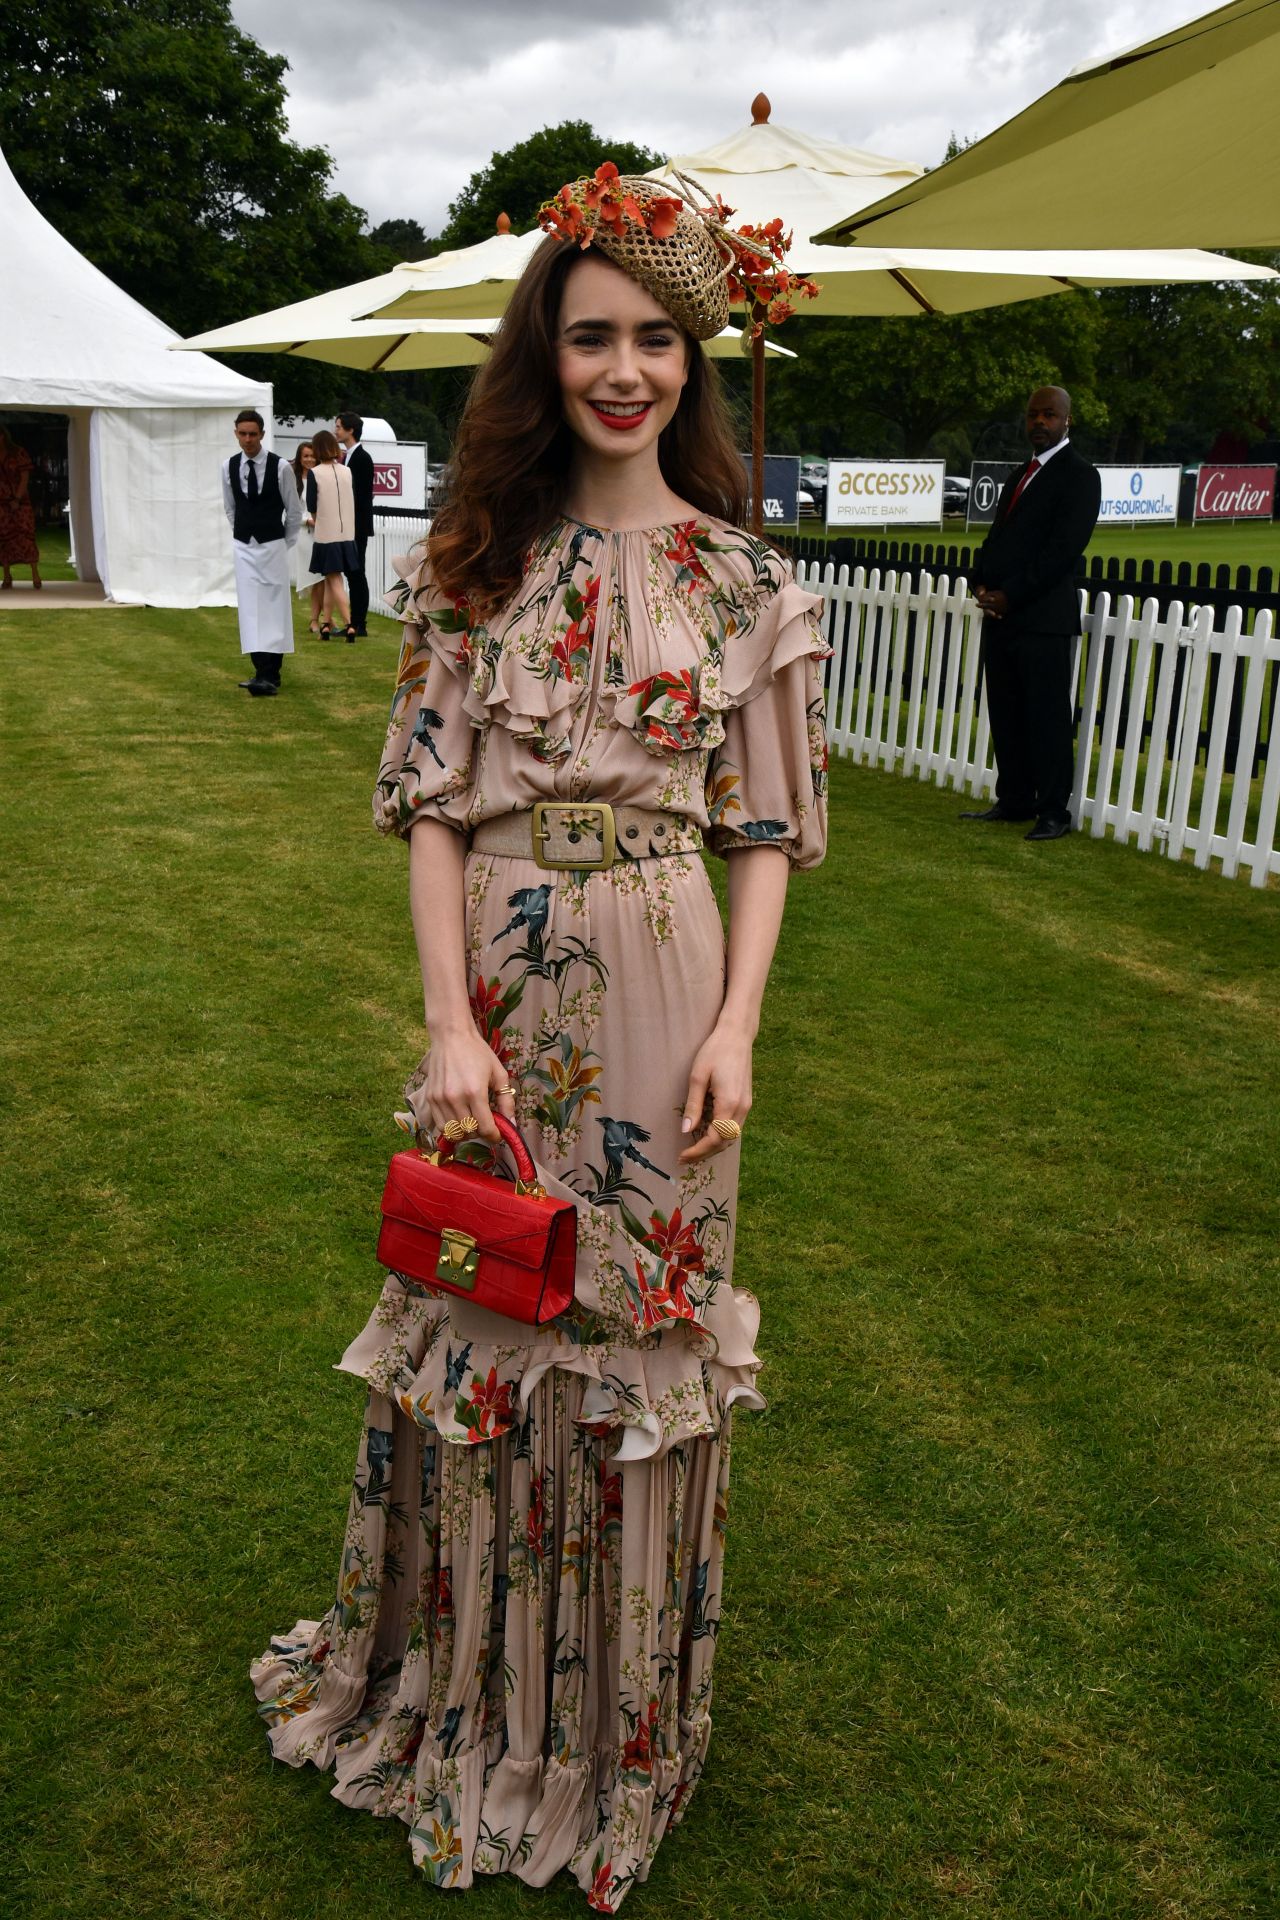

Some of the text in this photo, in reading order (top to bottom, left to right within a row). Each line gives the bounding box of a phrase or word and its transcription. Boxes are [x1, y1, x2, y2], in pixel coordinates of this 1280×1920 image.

[838, 472, 910, 495] access
[1200, 472, 1270, 512] Cartier
[837, 506, 909, 516] PRIVATE BANK
[1101, 494, 1164, 515] UT-SOURCING!
